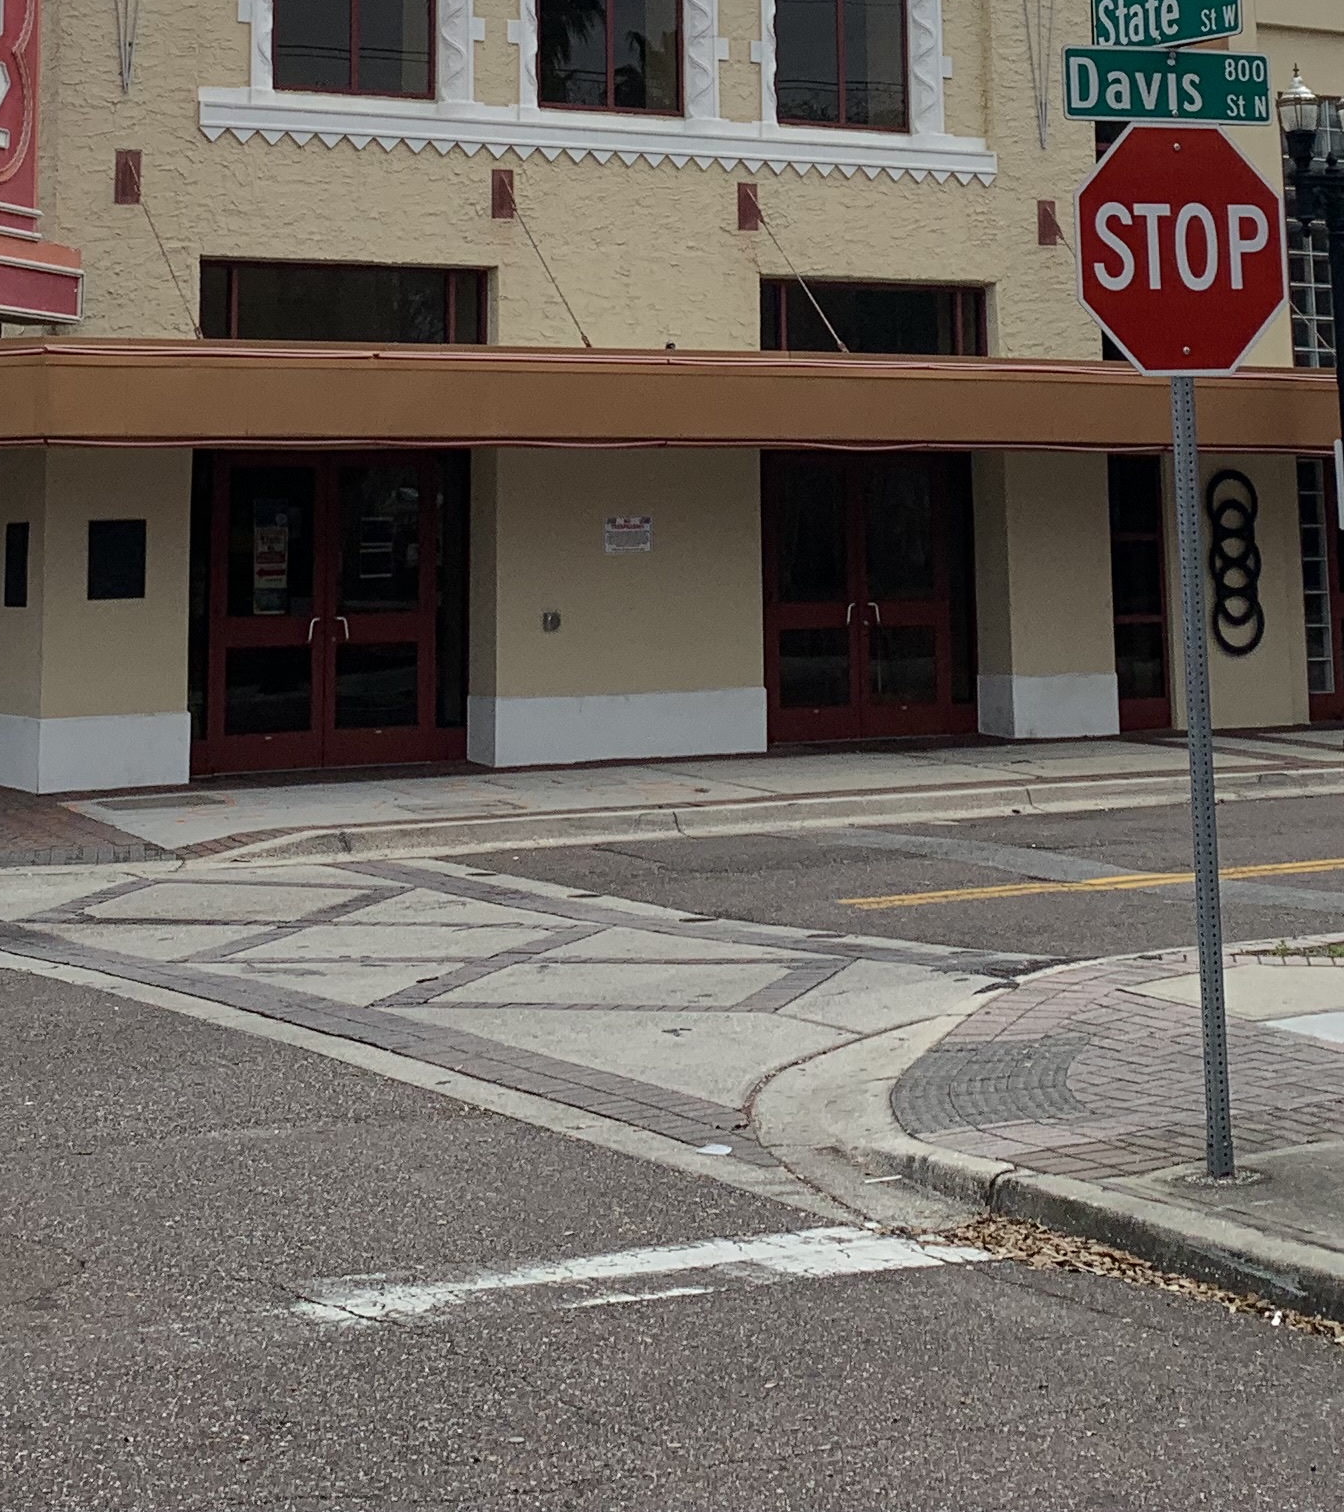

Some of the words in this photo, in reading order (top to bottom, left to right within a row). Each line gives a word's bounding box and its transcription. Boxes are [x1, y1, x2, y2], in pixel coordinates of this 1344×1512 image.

[1200, 9, 1217, 32] St
[1222, 4, 1236, 28] W
[1068, 56, 1203, 112] Davis
[1226, 94, 1246, 117] St
[1254, 96, 1267, 118] N
[1224, 58, 1265, 82] 800
[1093, 201, 1269, 292] STOP
